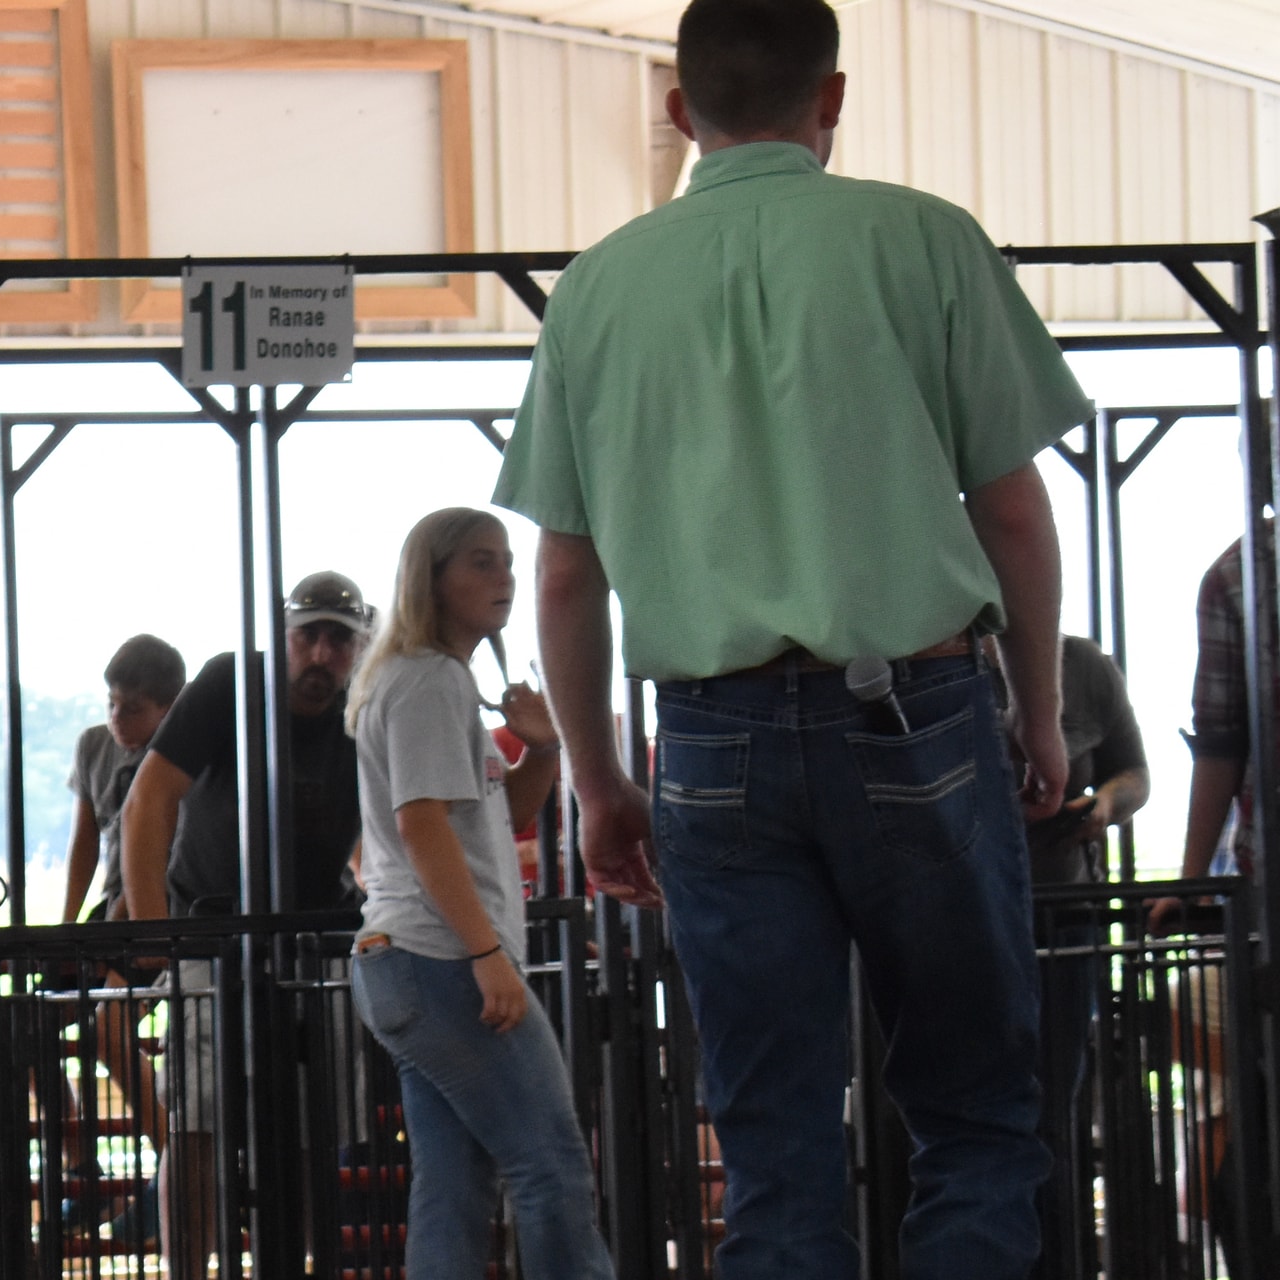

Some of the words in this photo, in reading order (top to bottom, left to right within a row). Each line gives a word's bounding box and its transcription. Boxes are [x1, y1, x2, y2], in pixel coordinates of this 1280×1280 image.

[251, 286, 263, 298] In
[269, 286, 327, 300] Memory
[333, 286, 347, 298] of
[190, 282, 245, 371] 11
[270, 307, 324, 327] Ranae
[257, 339, 337, 358] Donohoe
